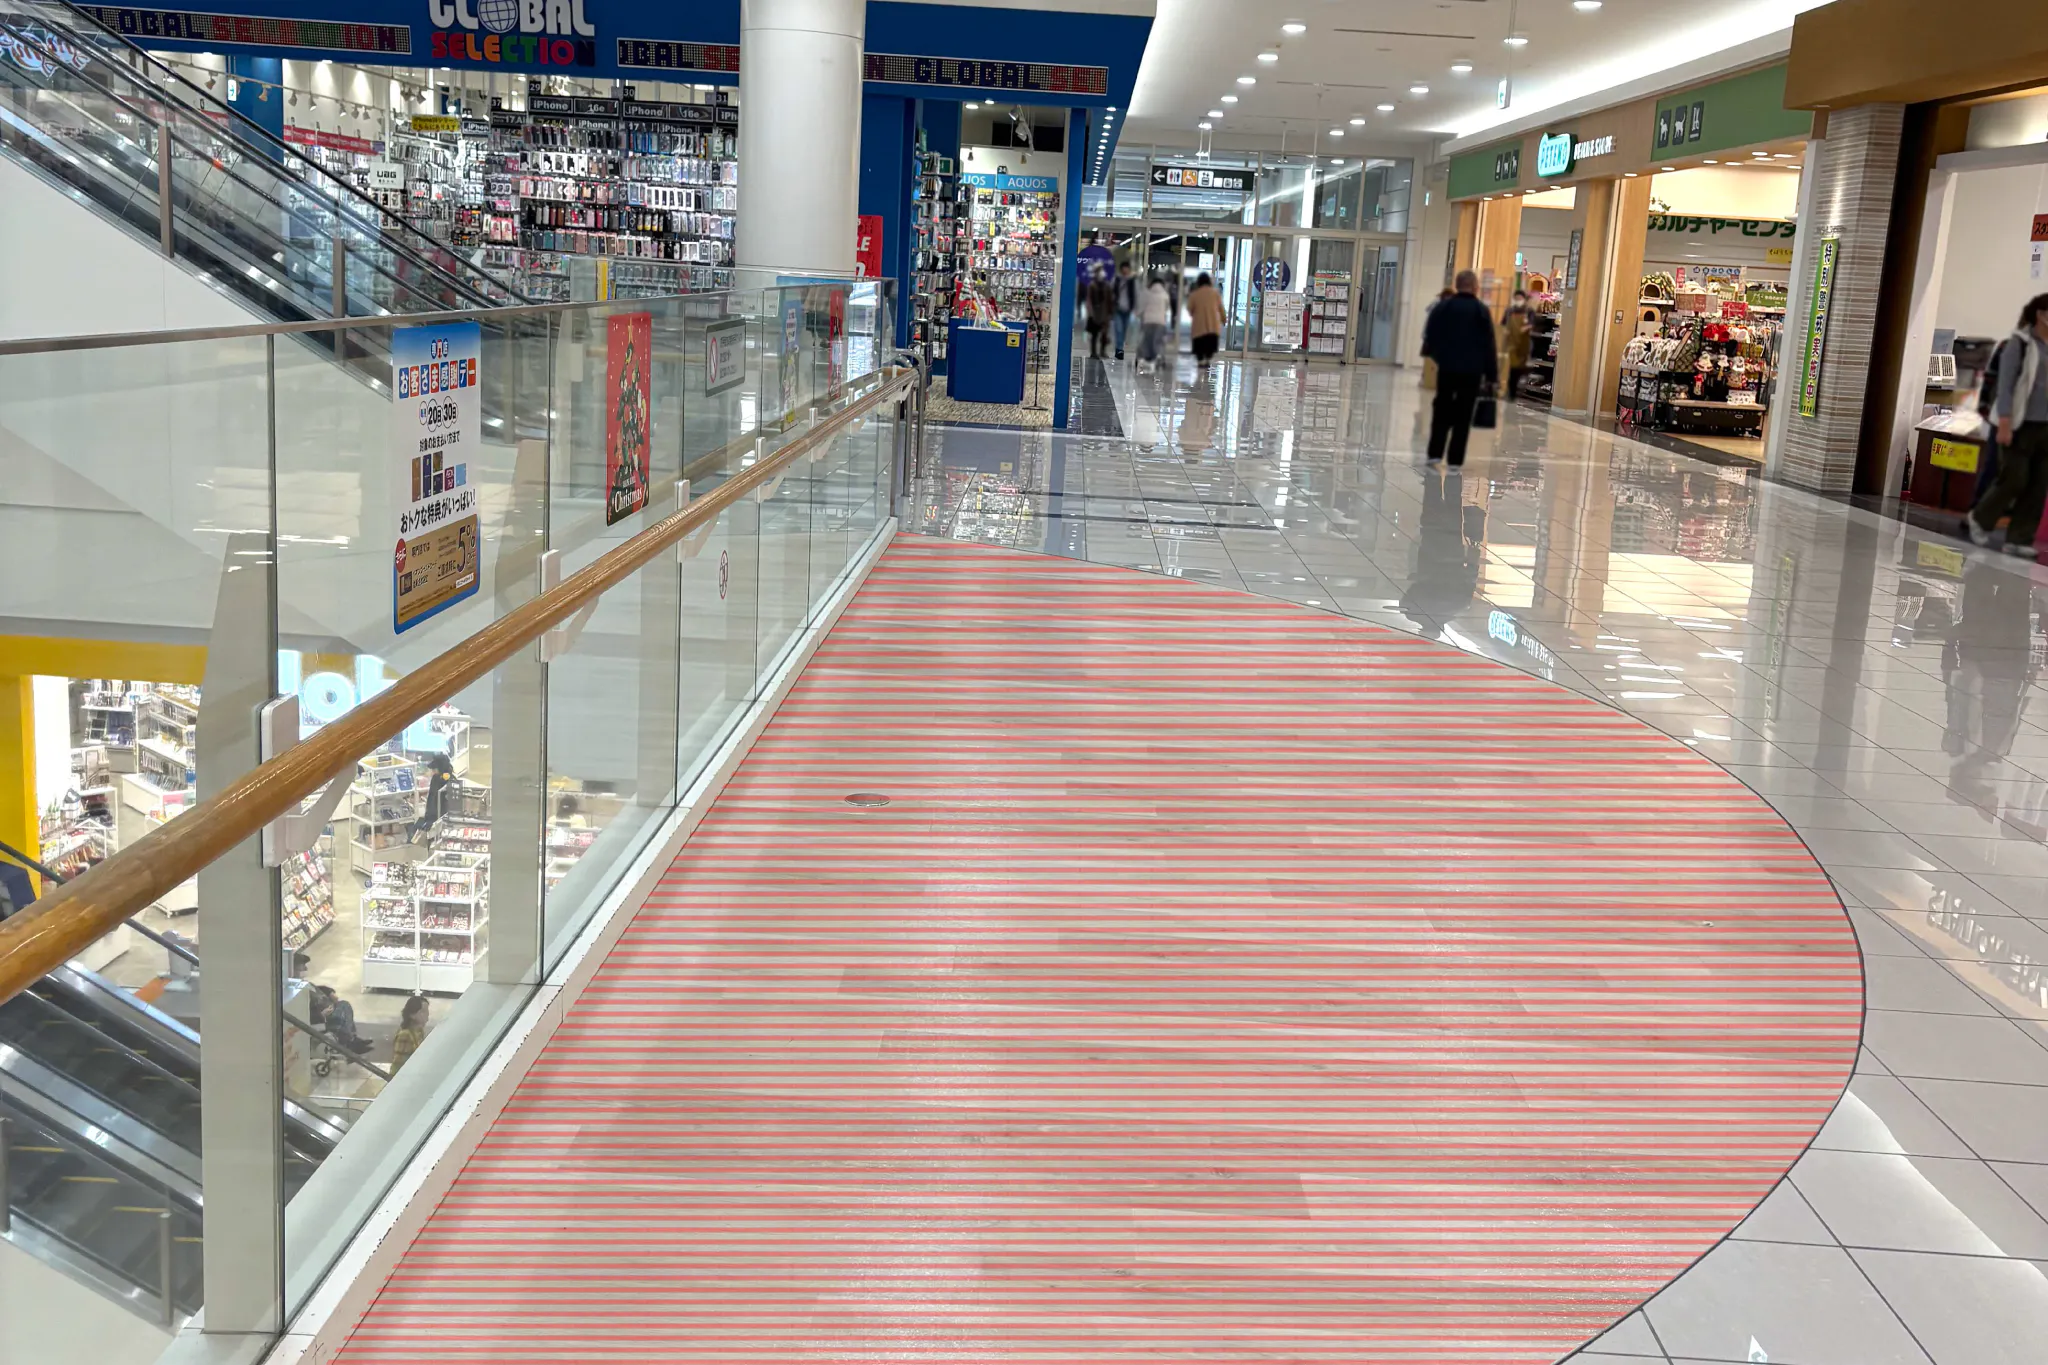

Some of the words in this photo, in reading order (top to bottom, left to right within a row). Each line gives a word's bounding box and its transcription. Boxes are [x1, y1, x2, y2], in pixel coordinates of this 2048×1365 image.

[94, 8, 204, 38] LOBAL
[431, 31, 596, 67] SELECTION
[914, 60, 1040, 89] GLOBAL
[529, 83, 541, 91] 29
[623, 88, 635, 97] 30
[717, 94, 727, 102] 31
[533, 100, 569, 110] iPhone
[588, 104, 605, 112] 16e
[628, 105, 663, 116] iPhone
[683, 110, 700, 118] 16e
[721, 111, 738, 120] iPh
[469, 122, 488, 131] iPhon
[579, 120, 609, 128] iPhone
[662, 124, 692, 133] iPhone
[960, 175, 986, 186] UOS
[1008, 177, 1047, 189] AQUOS
[400, 363, 475, 395] お客さま感謝デー
